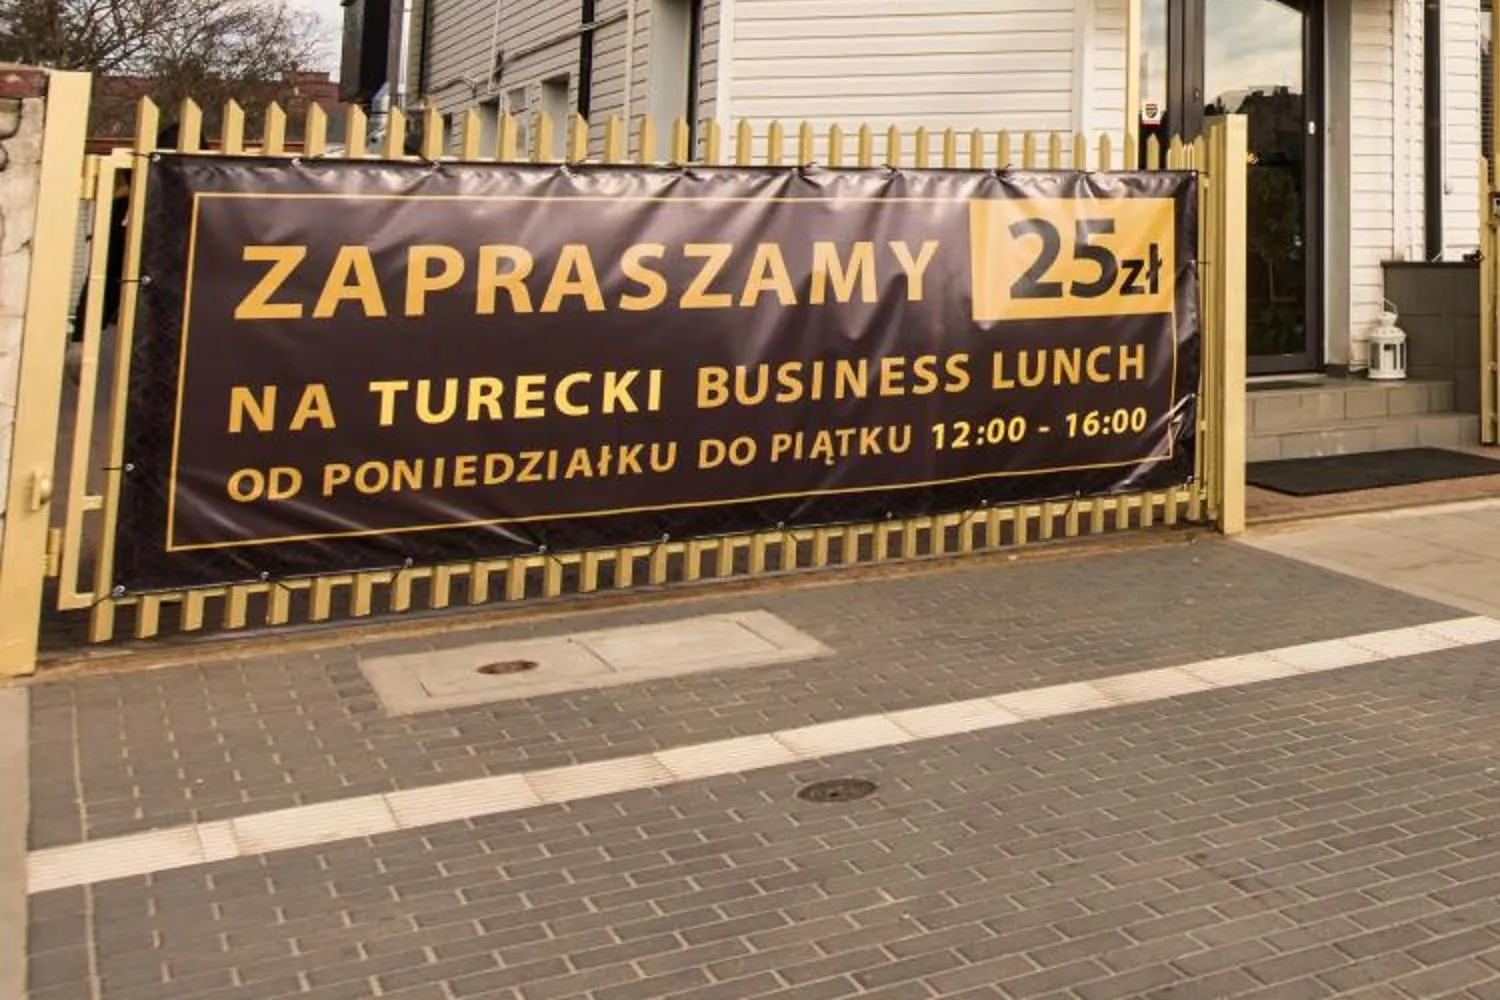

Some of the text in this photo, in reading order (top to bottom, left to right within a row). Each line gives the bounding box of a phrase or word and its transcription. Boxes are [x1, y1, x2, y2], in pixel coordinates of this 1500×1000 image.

[233, 239, 940, 320] ZAPRASZAMY
[227, 343, 1146, 434] NA TURECKI BUSINESS LUNCH
[226, 466, 304, 504] OD
[698, 435, 758, 469] DO
[769, 424, 913, 468] PIĄTKU
[931, 415, 1027, 451] 12:00
[1064, 406, 1148, 440] 16:00
